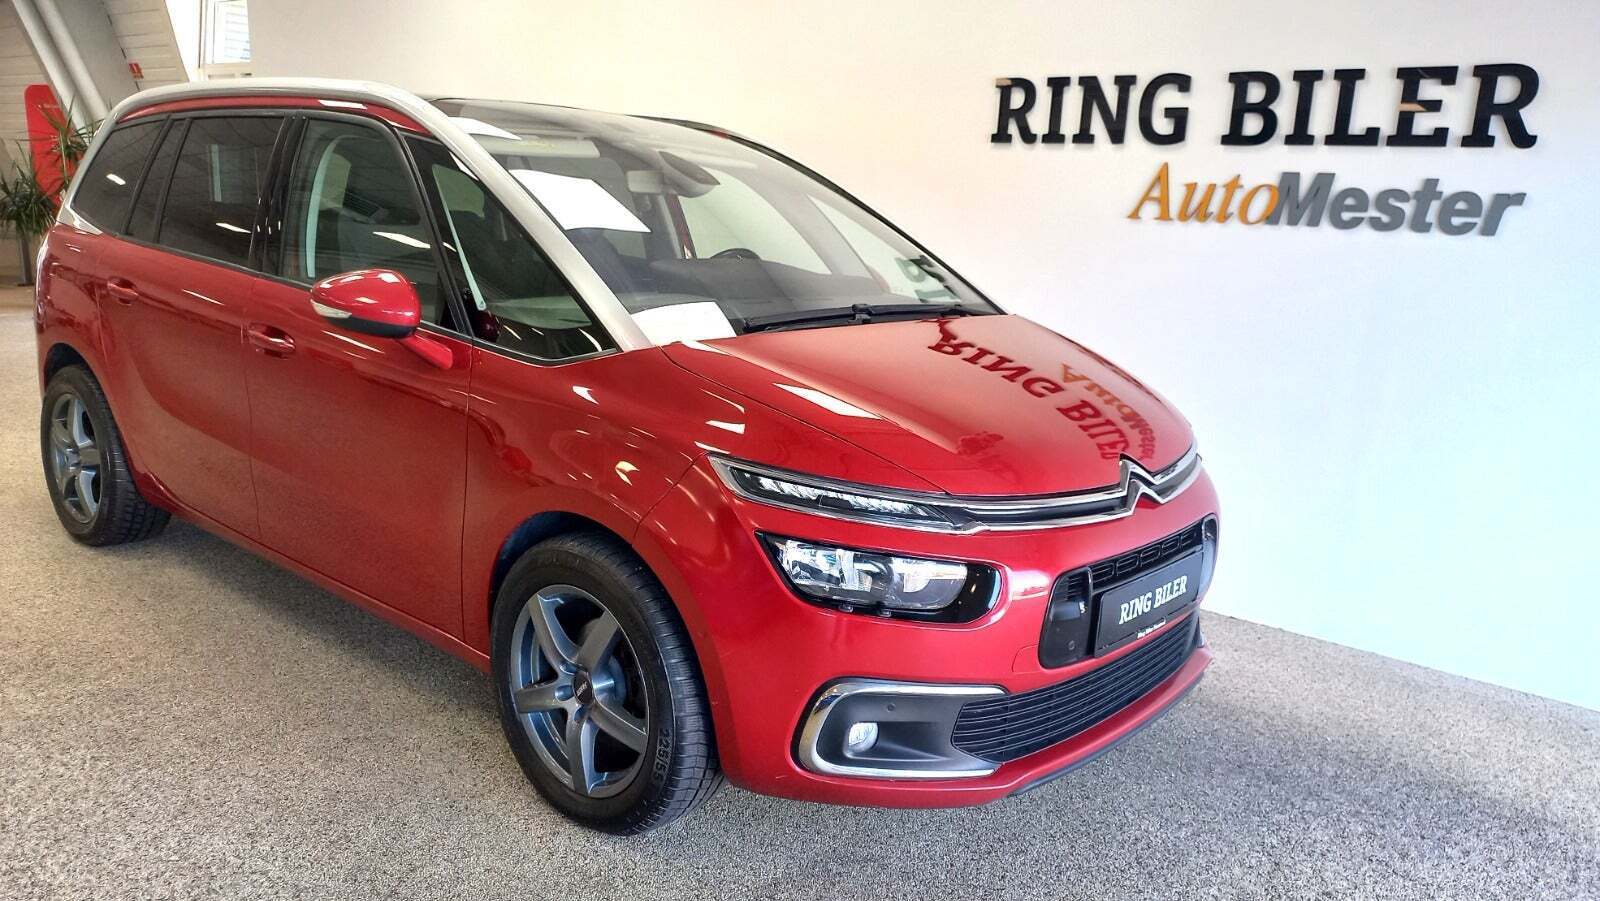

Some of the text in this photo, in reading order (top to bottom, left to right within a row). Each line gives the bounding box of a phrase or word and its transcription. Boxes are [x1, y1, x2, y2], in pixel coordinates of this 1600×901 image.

[990, 63, 1540, 149] RING BILER
[1127, 161, 1527, 236] AutoMester
[1118, 575, 1188, 625] RING BILER
